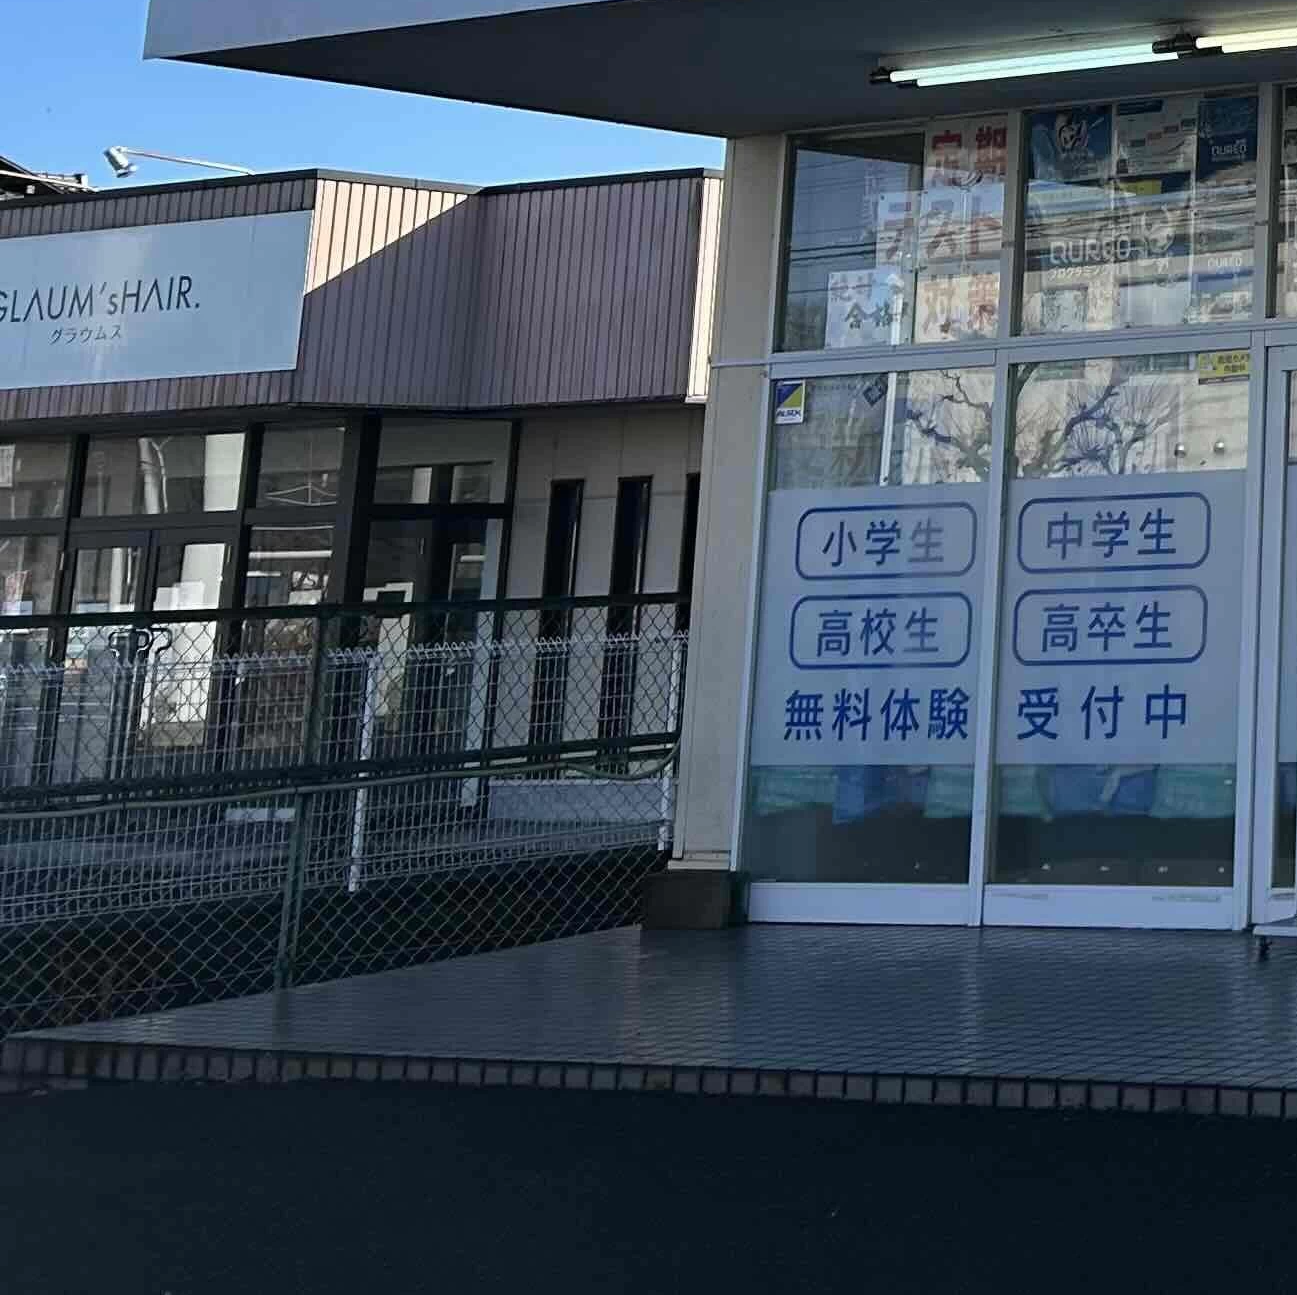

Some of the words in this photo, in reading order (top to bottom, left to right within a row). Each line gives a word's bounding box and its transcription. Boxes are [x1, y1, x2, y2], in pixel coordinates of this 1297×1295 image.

[48, 324, 122, 345] グラウムス
[821, 517, 945, 568] 小学生
[1045, 507, 1177, 562] 中学生
[814, 606, 940, 657] 高校生
[1040, 601, 1174, 654] 高卒生
[783, 685, 970, 743] 無料体験
[1016, 683, 1188, 742] 受付中
